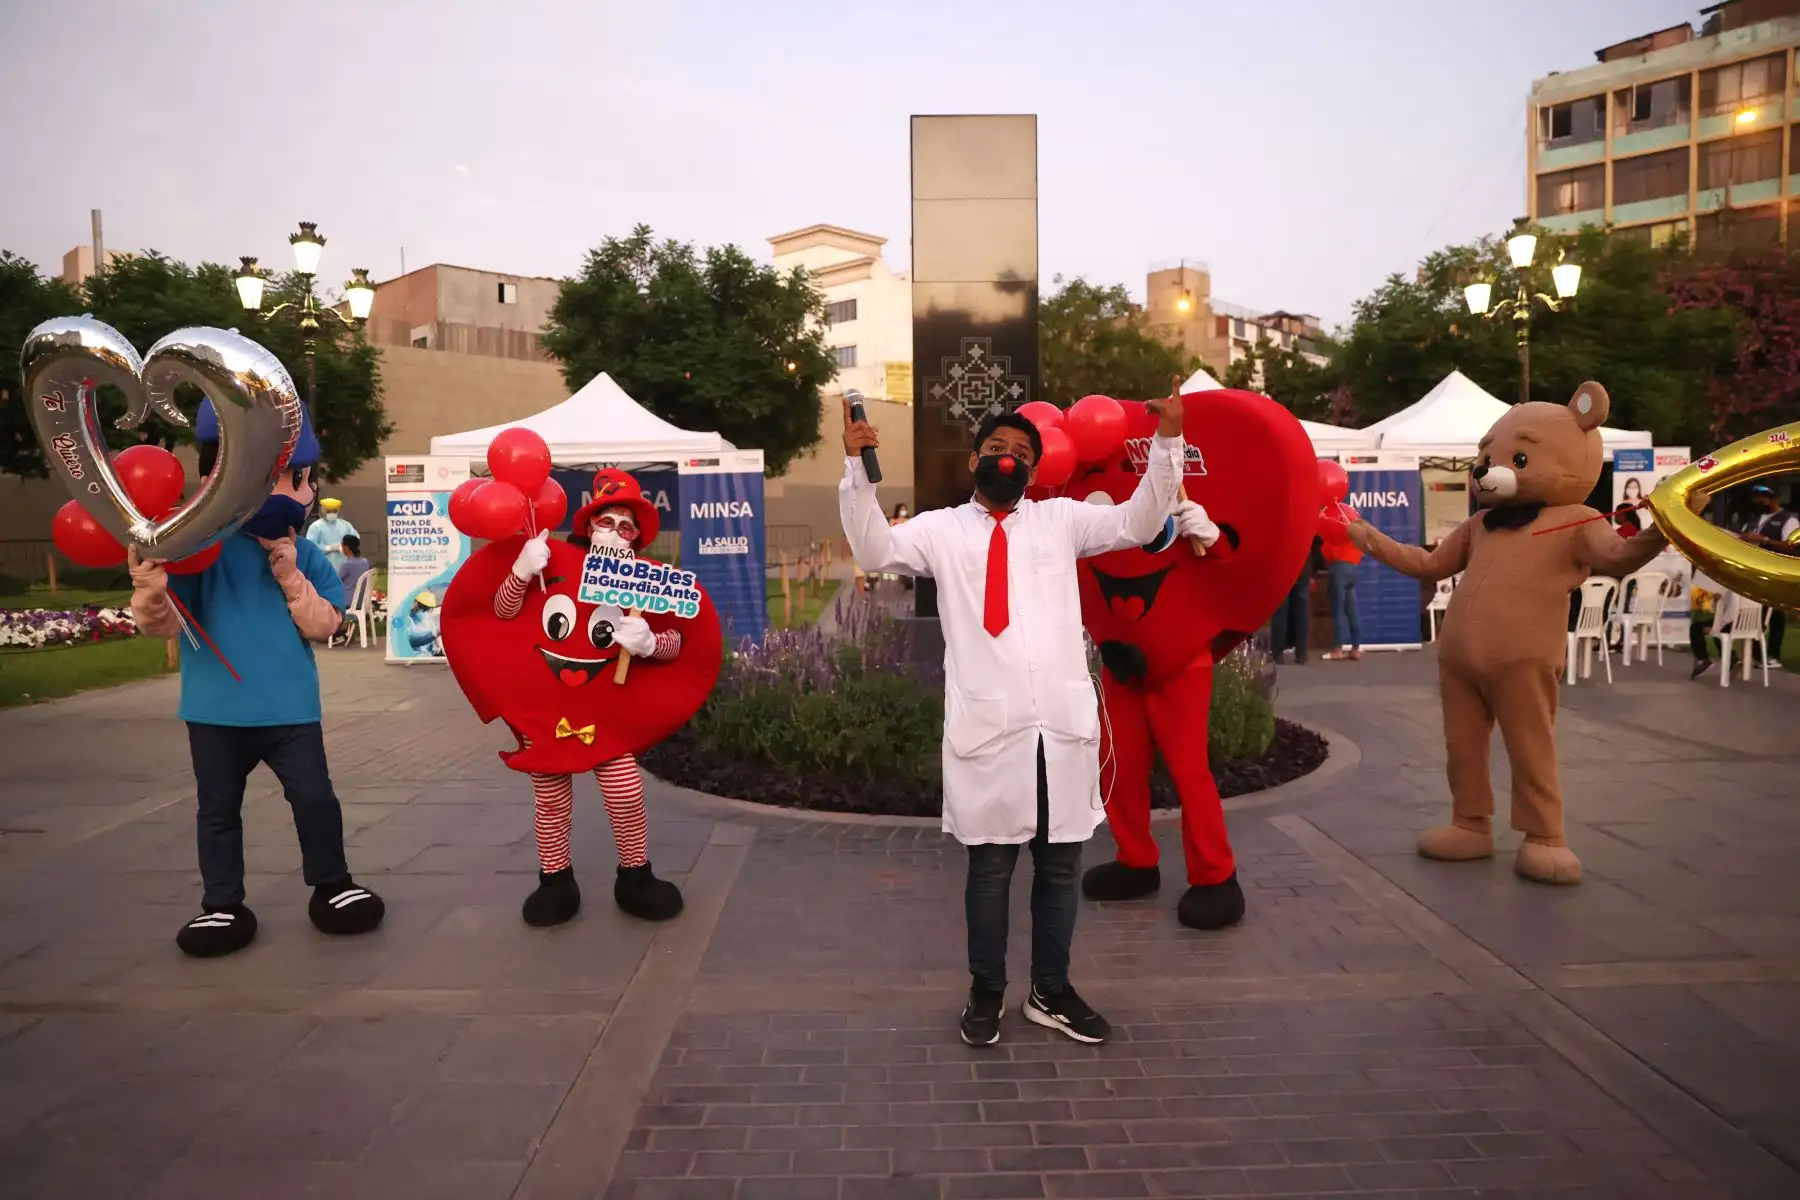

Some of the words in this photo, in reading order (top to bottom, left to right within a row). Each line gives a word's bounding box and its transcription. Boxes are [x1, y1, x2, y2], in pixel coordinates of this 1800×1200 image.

[41, 391, 65, 412] Te
[52, 433, 84, 479] Quiero
[1349, 491, 1409, 508] MINSA
[393, 501, 427, 515] AQUÍ
[690, 501, 754, 519] MINSA
[390, 519, 417, 527] TOMA
[418, 519, 431, 527] DE
[390, 527, 444, 535] MUESTRAS
[390, 536, 450, 546] COVID-19
[698, 537, 713, 547] LA
[714, 536, 748, 546] SALUD
[591, 544, 634, 560] MINSA
[586, 555, 693, 587] #NoBajes
[580, 585, 698, 617] LaCOVID-19
